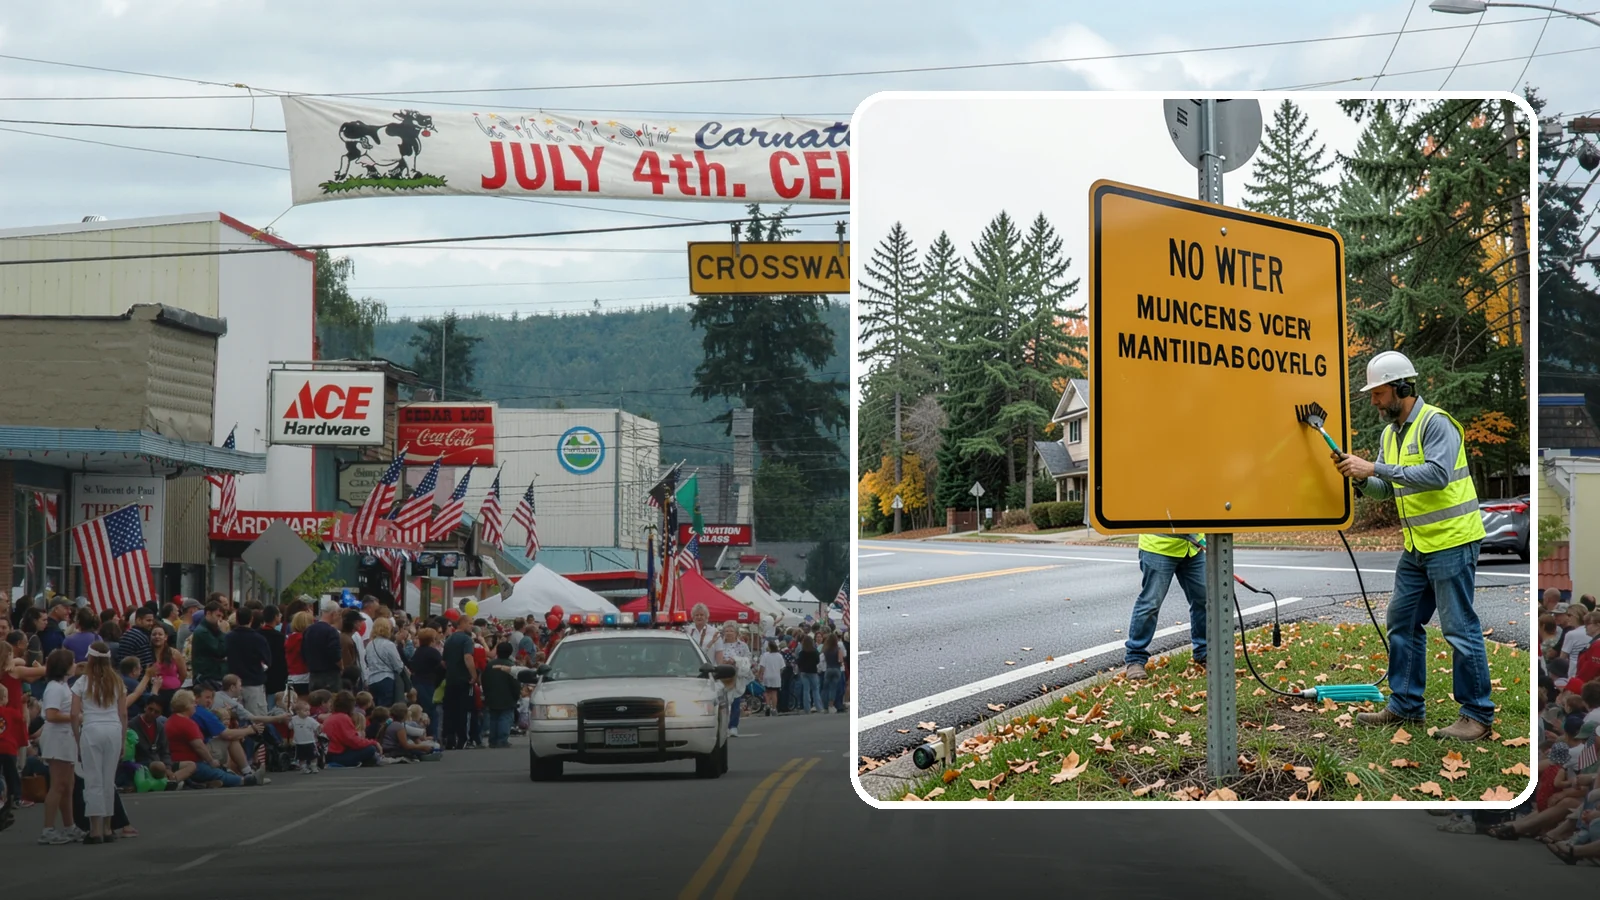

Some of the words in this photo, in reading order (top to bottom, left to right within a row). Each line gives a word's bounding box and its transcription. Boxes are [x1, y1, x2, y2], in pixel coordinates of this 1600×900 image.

[695, 121, 849, 150] Carnat
[481, 140, 604, 192] JULY
[633, 150, 746, 198] 4th.
[697, 254, 850, 280] CROSSWA
[1169, 237, 1204, 281] NO
[1215, 244, 1283, 294] WTER
[1137, 293, 1251, 333] MUNCENS
[282, 380, 374, 420] ACE
[406, 409, 453, 422] CEDAR
[284, 421, 371, 436] Hardware
[416, 427, 477, 447] Coca-Cola
[353, 466, 387, 481] Simpl
[83, 484, 94, 495] St.
[96, 485, 124, 495] Vincent
[126, 486, 136, 495] de
[138, 485, 155, 495] Paul
[688, 526, 741, 535] CRNATION
[699, 535, 730, 544] GLASS
